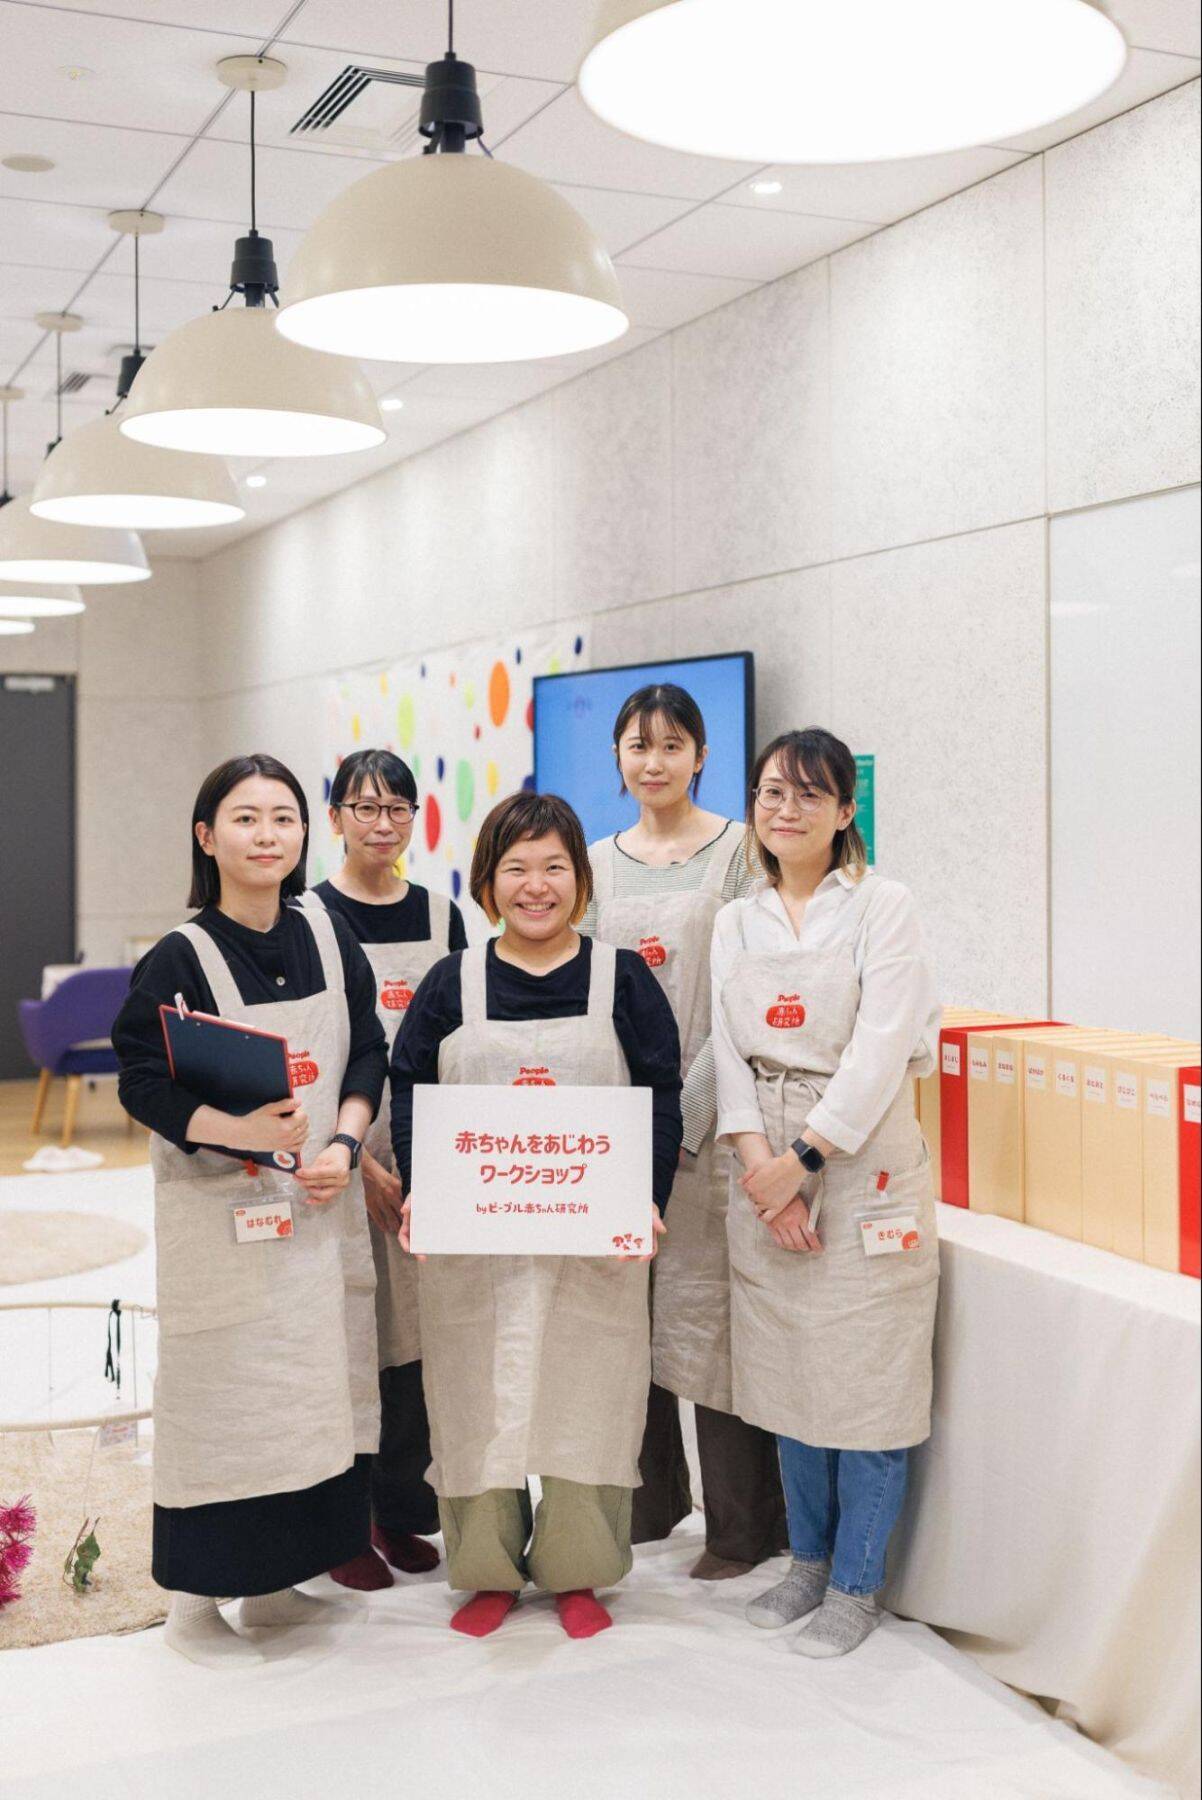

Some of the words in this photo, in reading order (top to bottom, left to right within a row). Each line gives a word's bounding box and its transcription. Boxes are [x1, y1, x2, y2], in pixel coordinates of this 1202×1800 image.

[519, 1067, 549, 1075] People
[454, 1131, 611, 1155] 赤ちゃんをあじわう
[479, 1163, 588, 1185] ワークショップ
[877, 1229, 903, 1241] きむら
